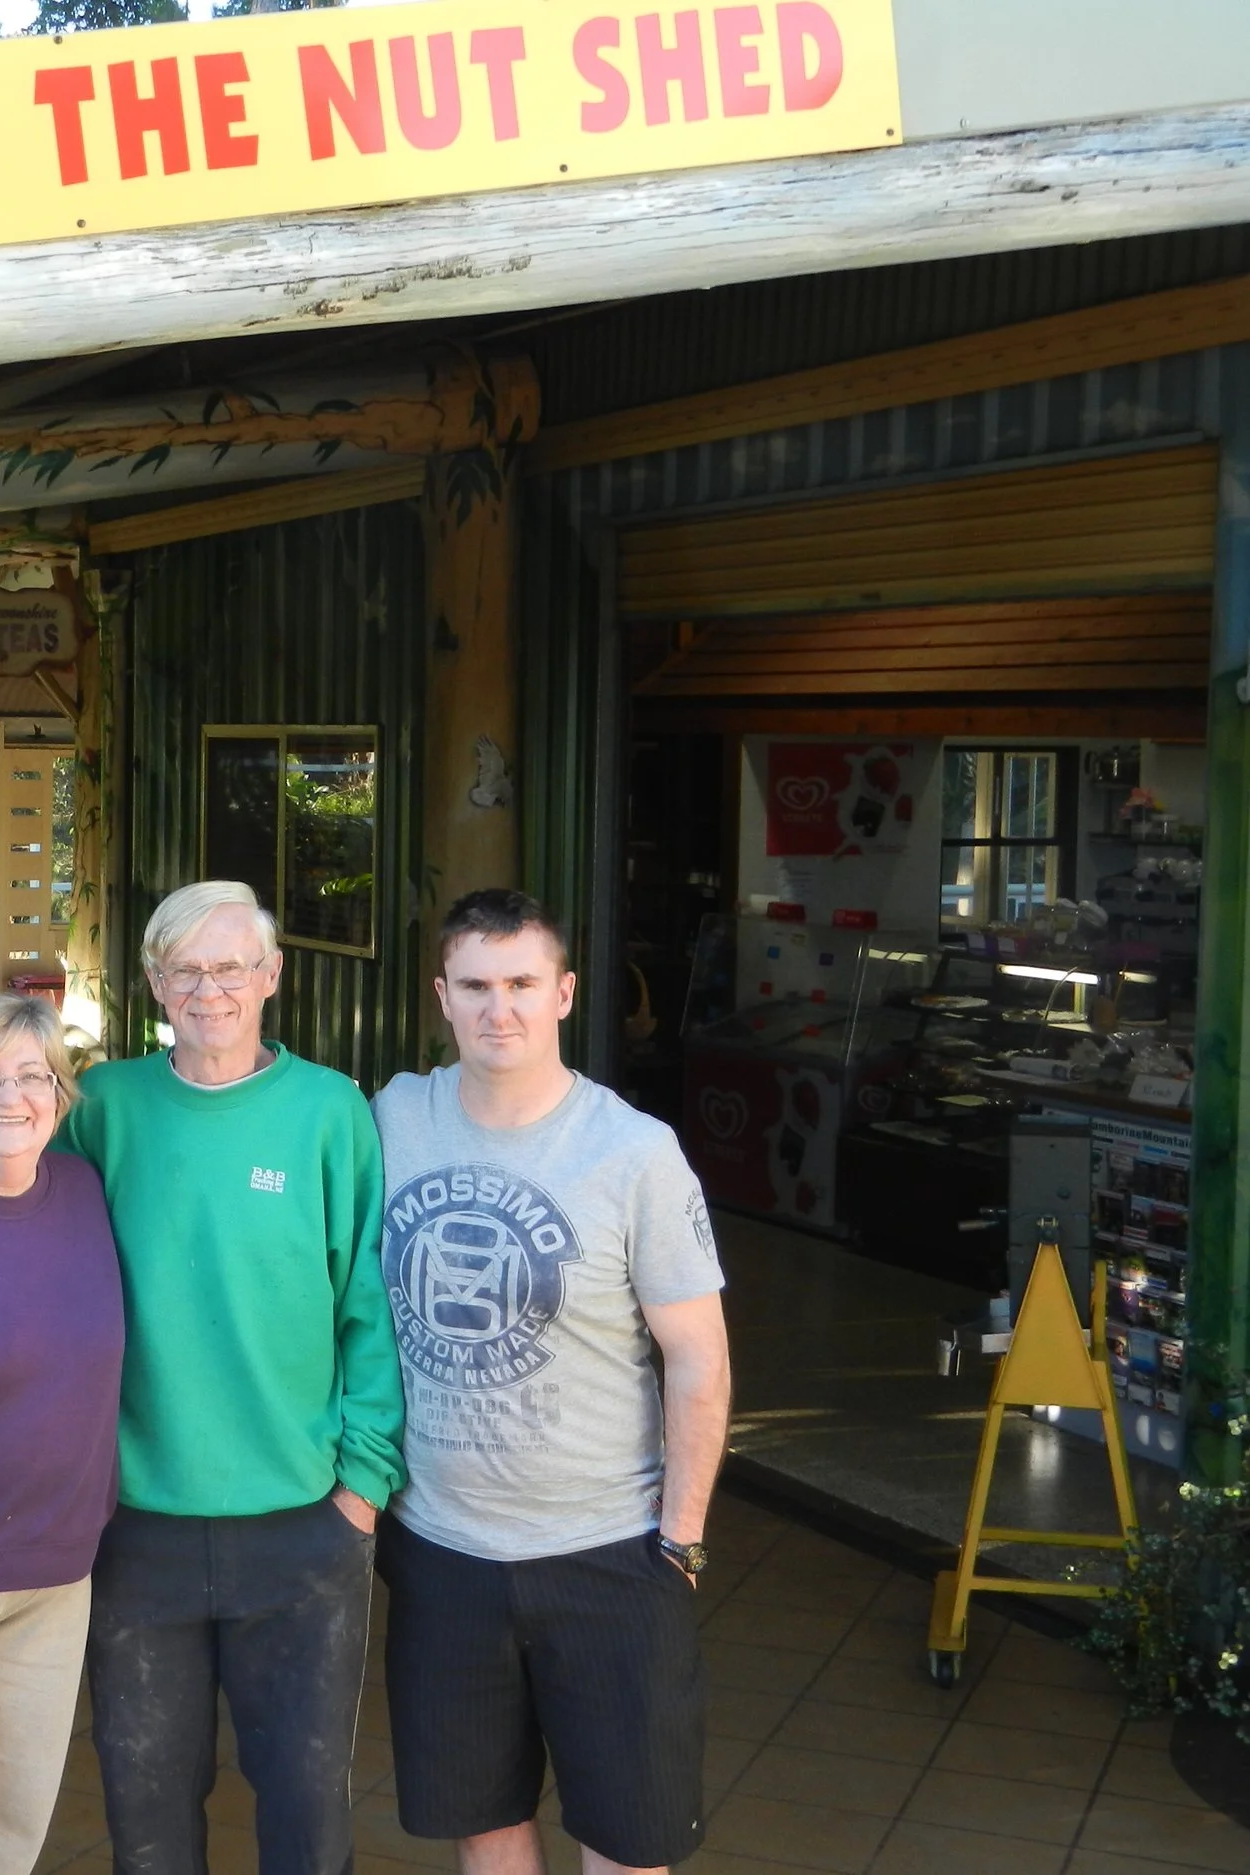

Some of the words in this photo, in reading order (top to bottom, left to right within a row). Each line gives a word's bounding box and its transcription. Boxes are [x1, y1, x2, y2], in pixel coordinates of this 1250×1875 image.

[33, 51, 260, 187] THE
[297, 26, 527, 161] NUT
[571, 2, 845, 135] SHED
[1092, 1121, 1192, 1148] amborineMountai
[391, 1173, 566, 1254] MOSSIMO
[389, 1287, 474, 1364] CUSTOM
[485, 1305, 549, 1362] MADE
[401, 1336, 455, 1384] SIERRA
[465, 1351, 541, 1386] NEVADA
